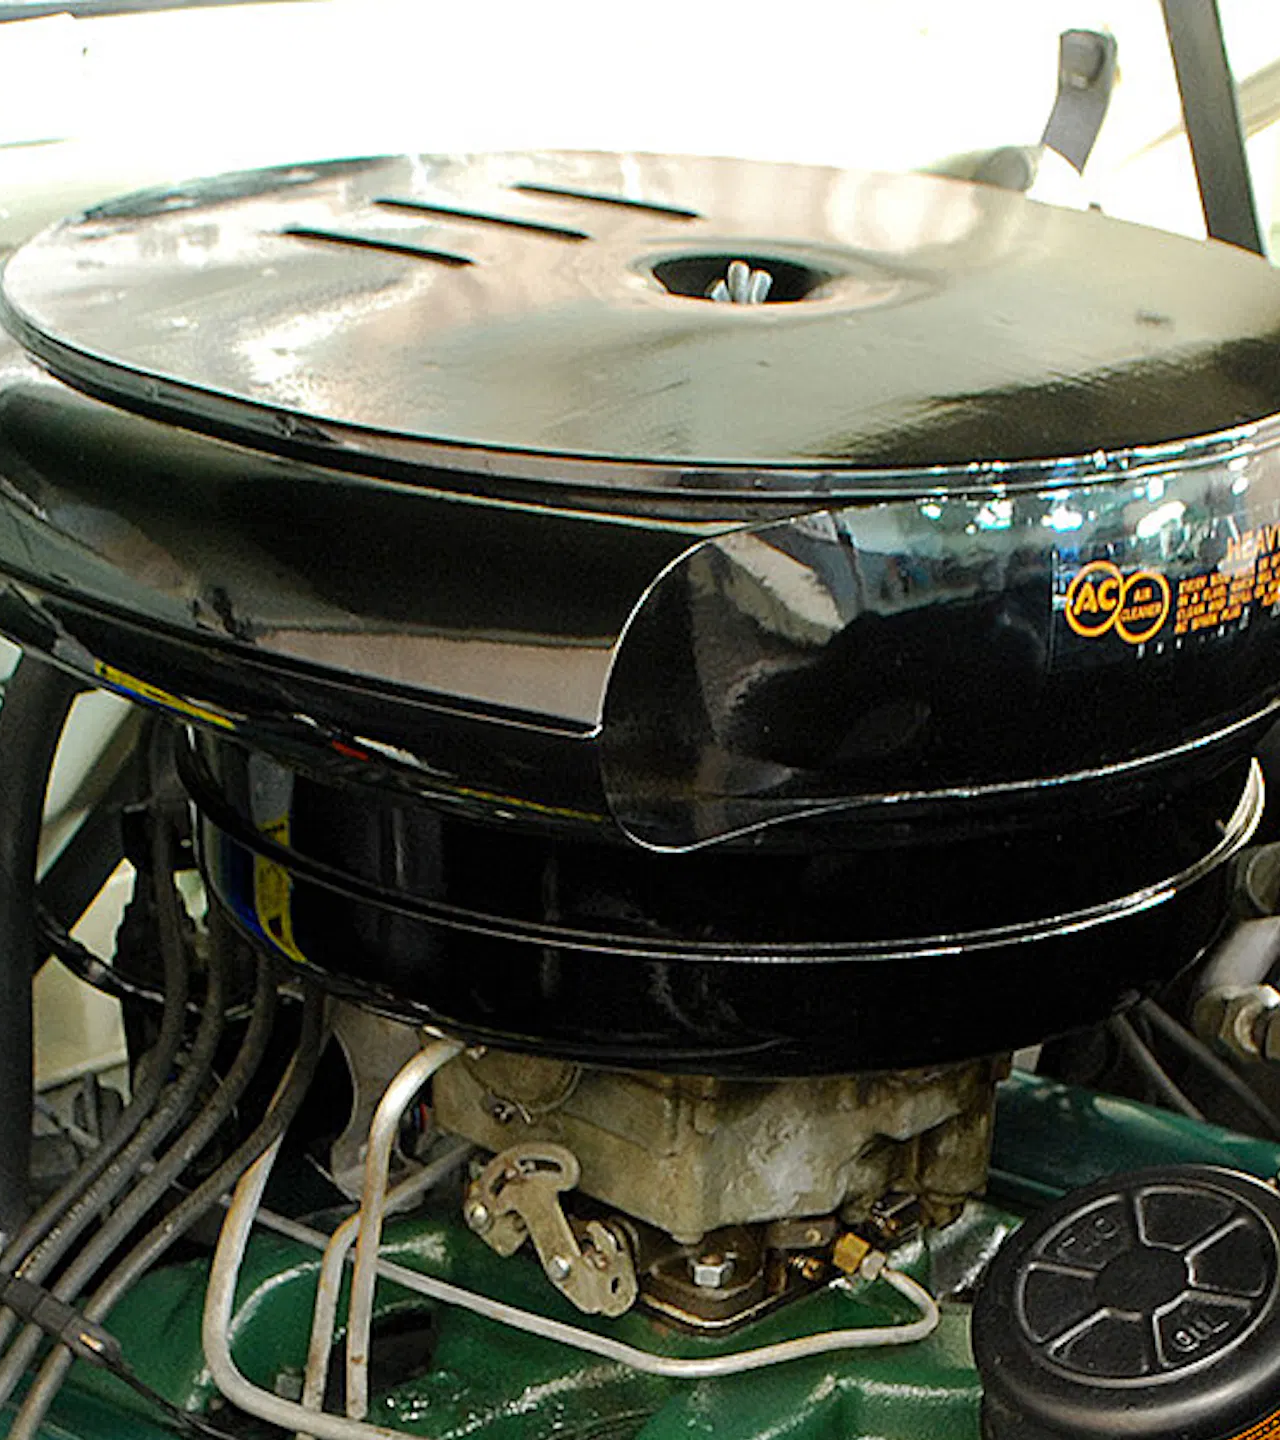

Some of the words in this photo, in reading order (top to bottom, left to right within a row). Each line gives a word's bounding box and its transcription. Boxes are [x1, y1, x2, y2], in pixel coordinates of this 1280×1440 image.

[1074, 578, 1119, 615] AC
[1134, 587, 1153, 603] AIR
[1120, 601, 1162, 622] CLEANER
[1171, 1319, 1230, 1353] OIL
